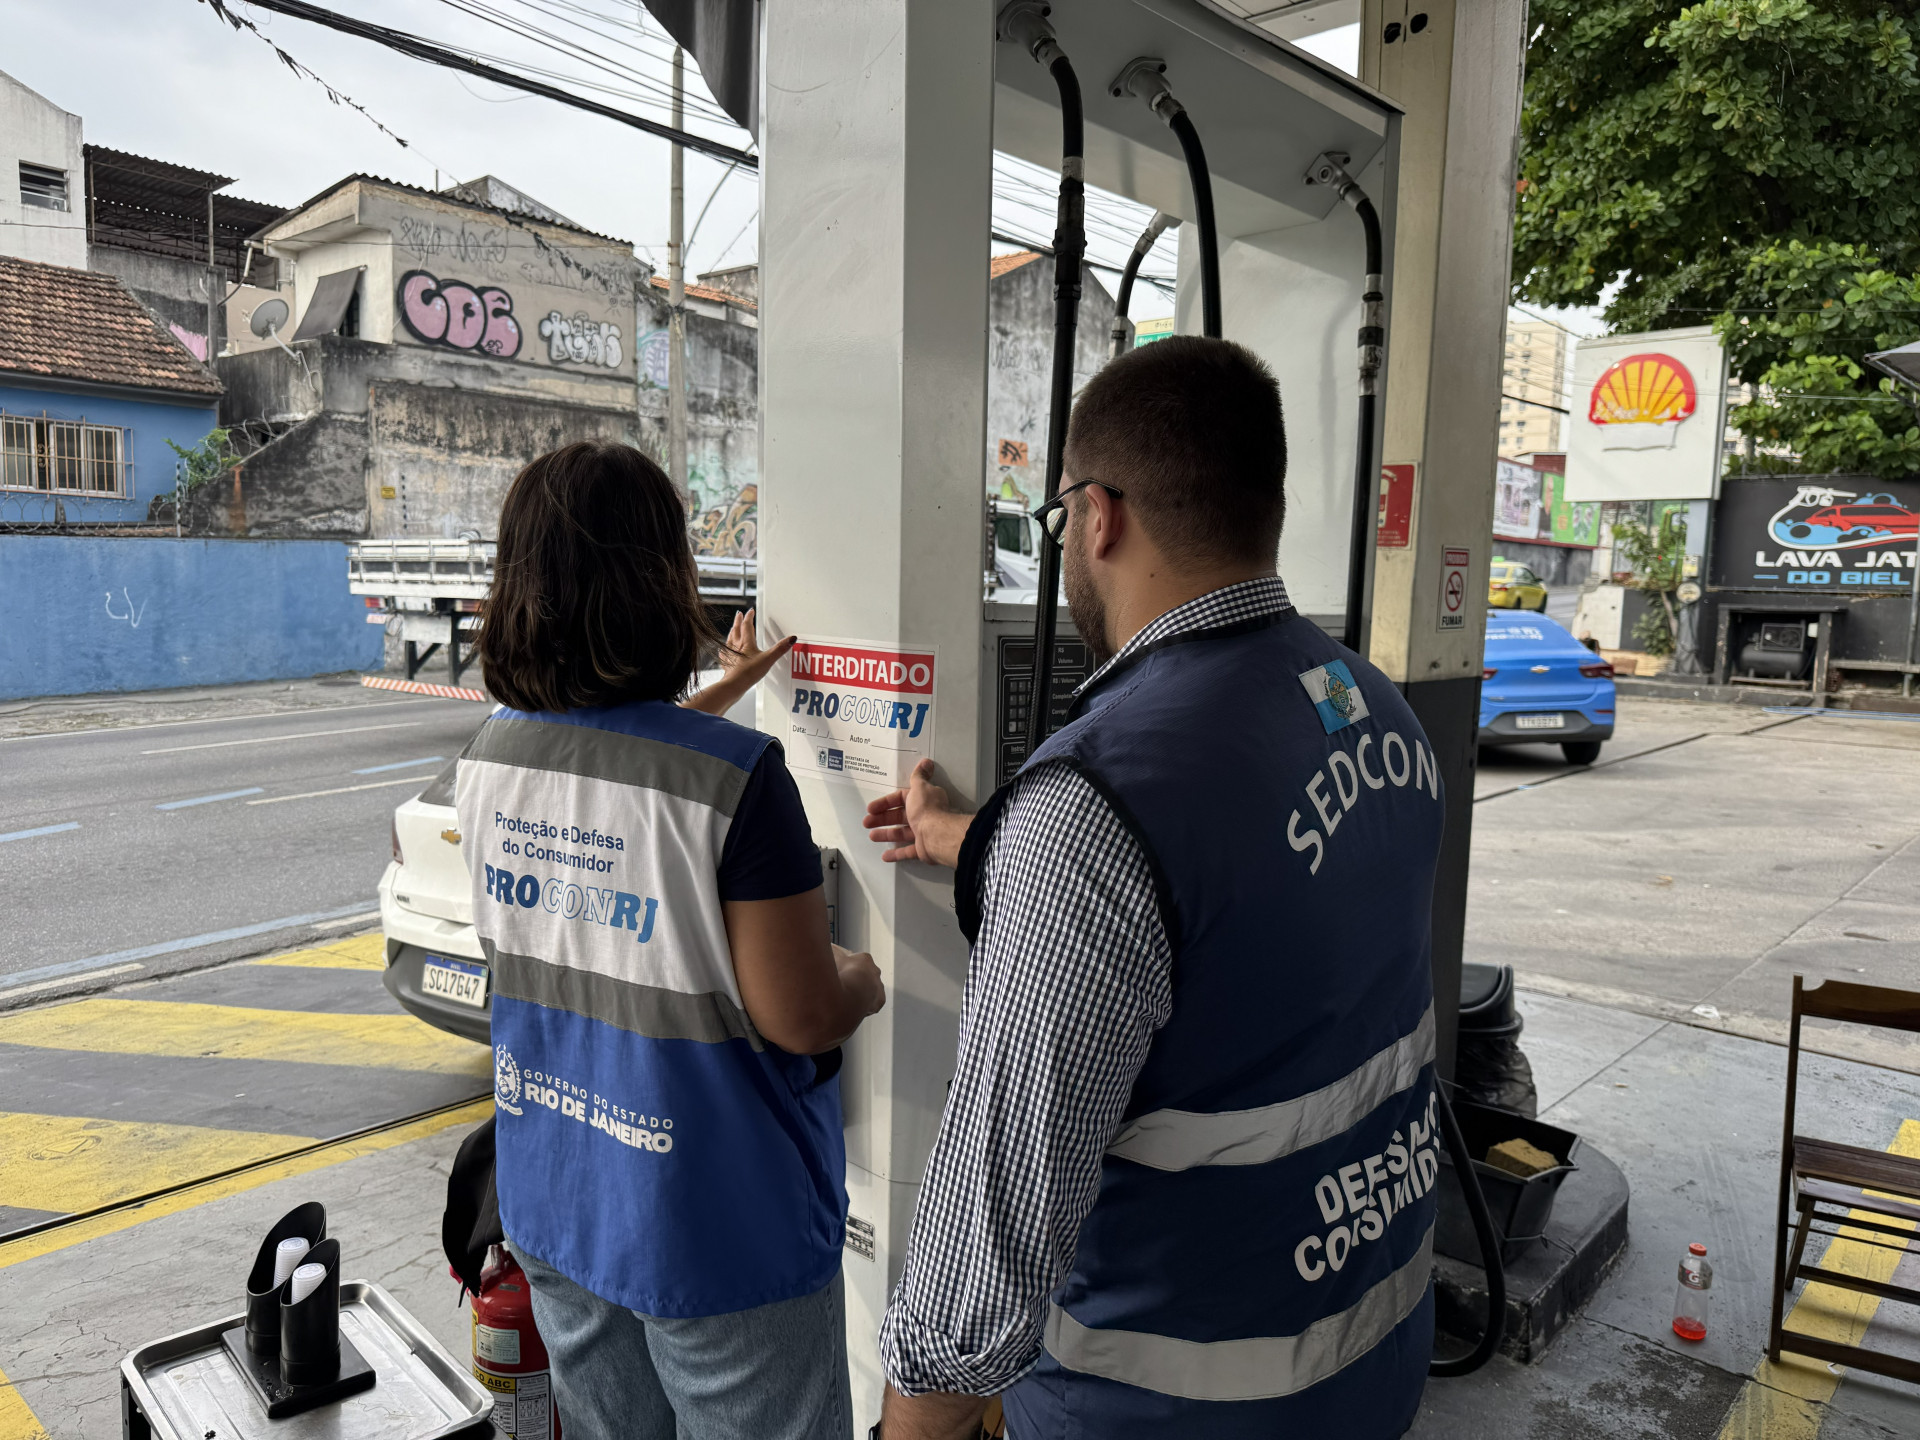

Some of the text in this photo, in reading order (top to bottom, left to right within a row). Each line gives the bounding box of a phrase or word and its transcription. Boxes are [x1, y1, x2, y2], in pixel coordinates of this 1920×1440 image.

[1755, 551, 1843, 568] LAVA
[1786, 571, 1911, 585] DO BIEL
[1441, 615, 1463, 626] FUMAR
[793, 651, 930, 687] INTERDITADO
[792, 688, 929, 738] PROCONRJ
[792, 724, 807, 734] Data:
[849, 735, 863, 744] Auto
[1287, 731, 1438, 876] SEDCON
[495, 811, 624, 851] Proteção e Defesa
[502, 838, 614, 873] do Consumidor
[485, 863, 659, 943] PROCONRJ
[524, 1069, 673, 1129] GOVERNO DO ESTADO
[524, 1082, 673, 1153] RIO DE JANEIRO
[487, 1377, 511, 1389] ABC
